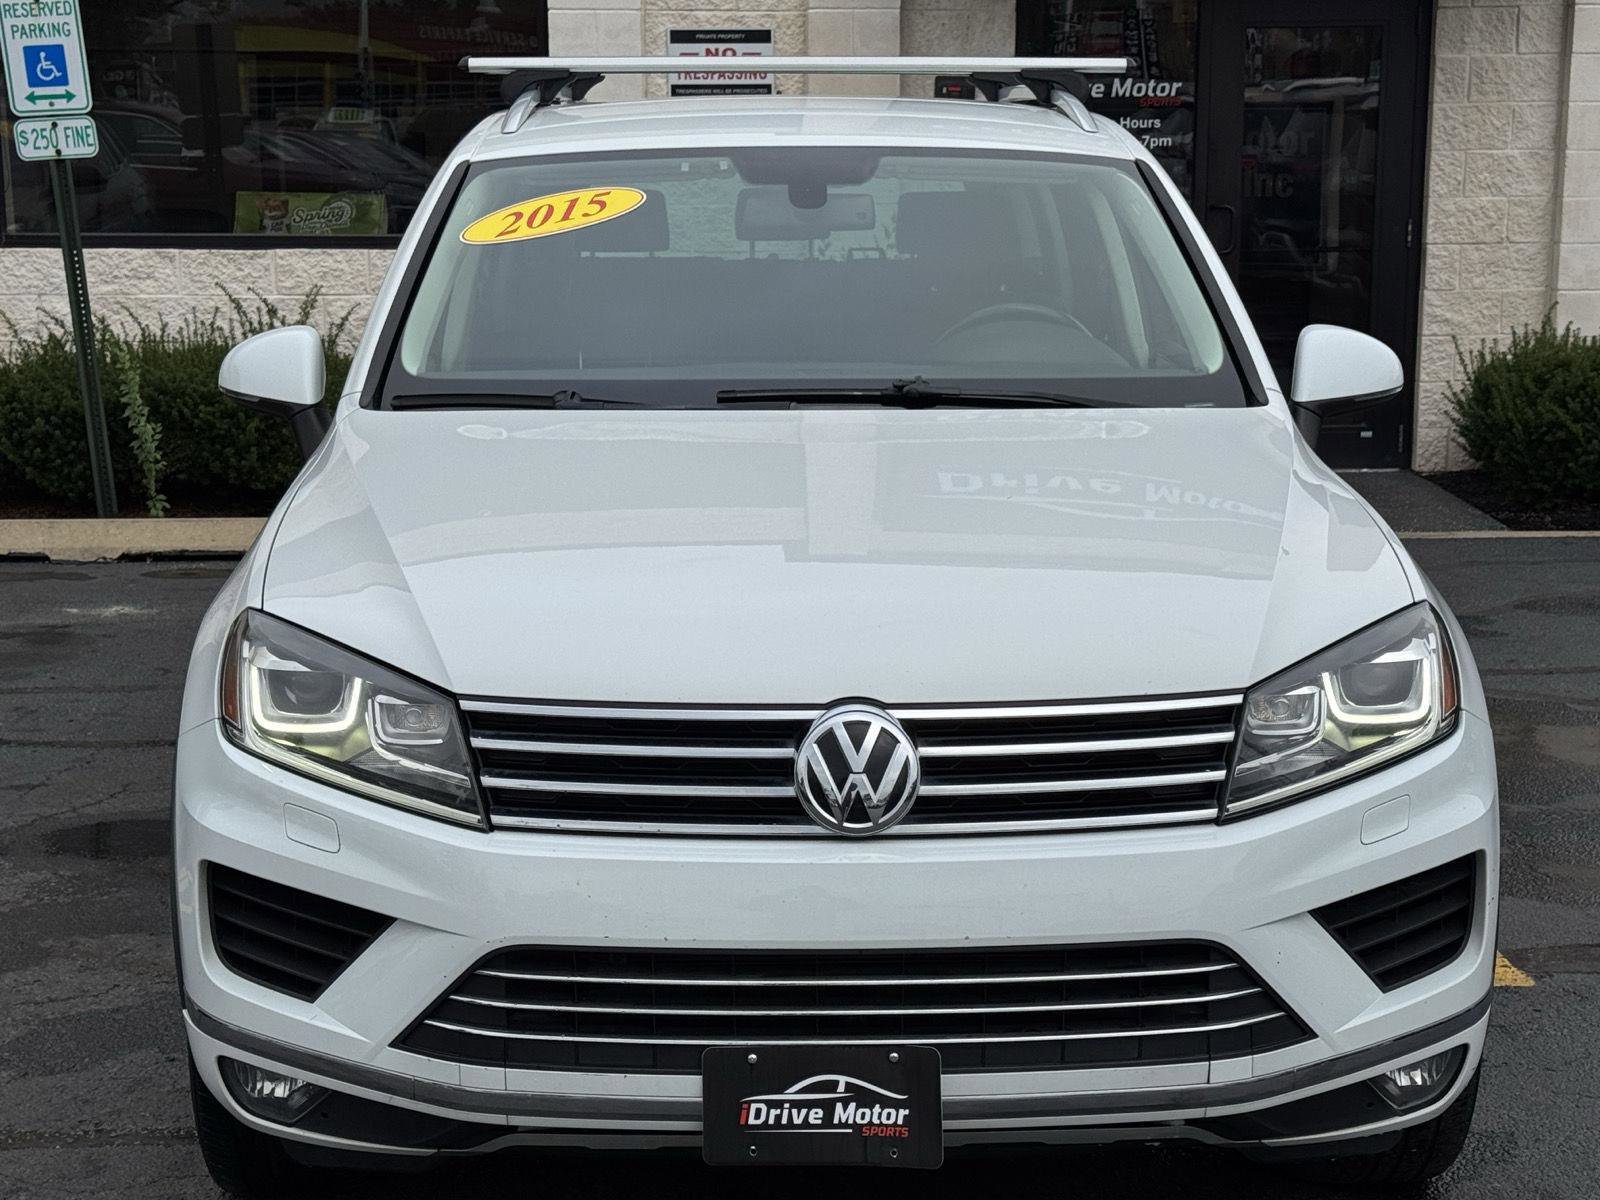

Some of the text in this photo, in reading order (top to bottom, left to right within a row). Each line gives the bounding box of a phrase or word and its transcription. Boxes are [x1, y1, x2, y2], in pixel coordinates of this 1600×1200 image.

[3, 1, 73, 18] RESERVED
[11, 22, 72, 39] PARKING
[704, 47, 737, 57] NO
[1110, 77, 1183, 98] Motor
[1120, 116, 1162, 129] Hours
[19, 124, 95, 150] $250 FINE
[293, 207, 347, 225] Spring
[494, 191, 612, 239] 2015
[739, 1102, 910, 1125] iDrive Motor
[862, 1126, 909, 1137] SPORTS
